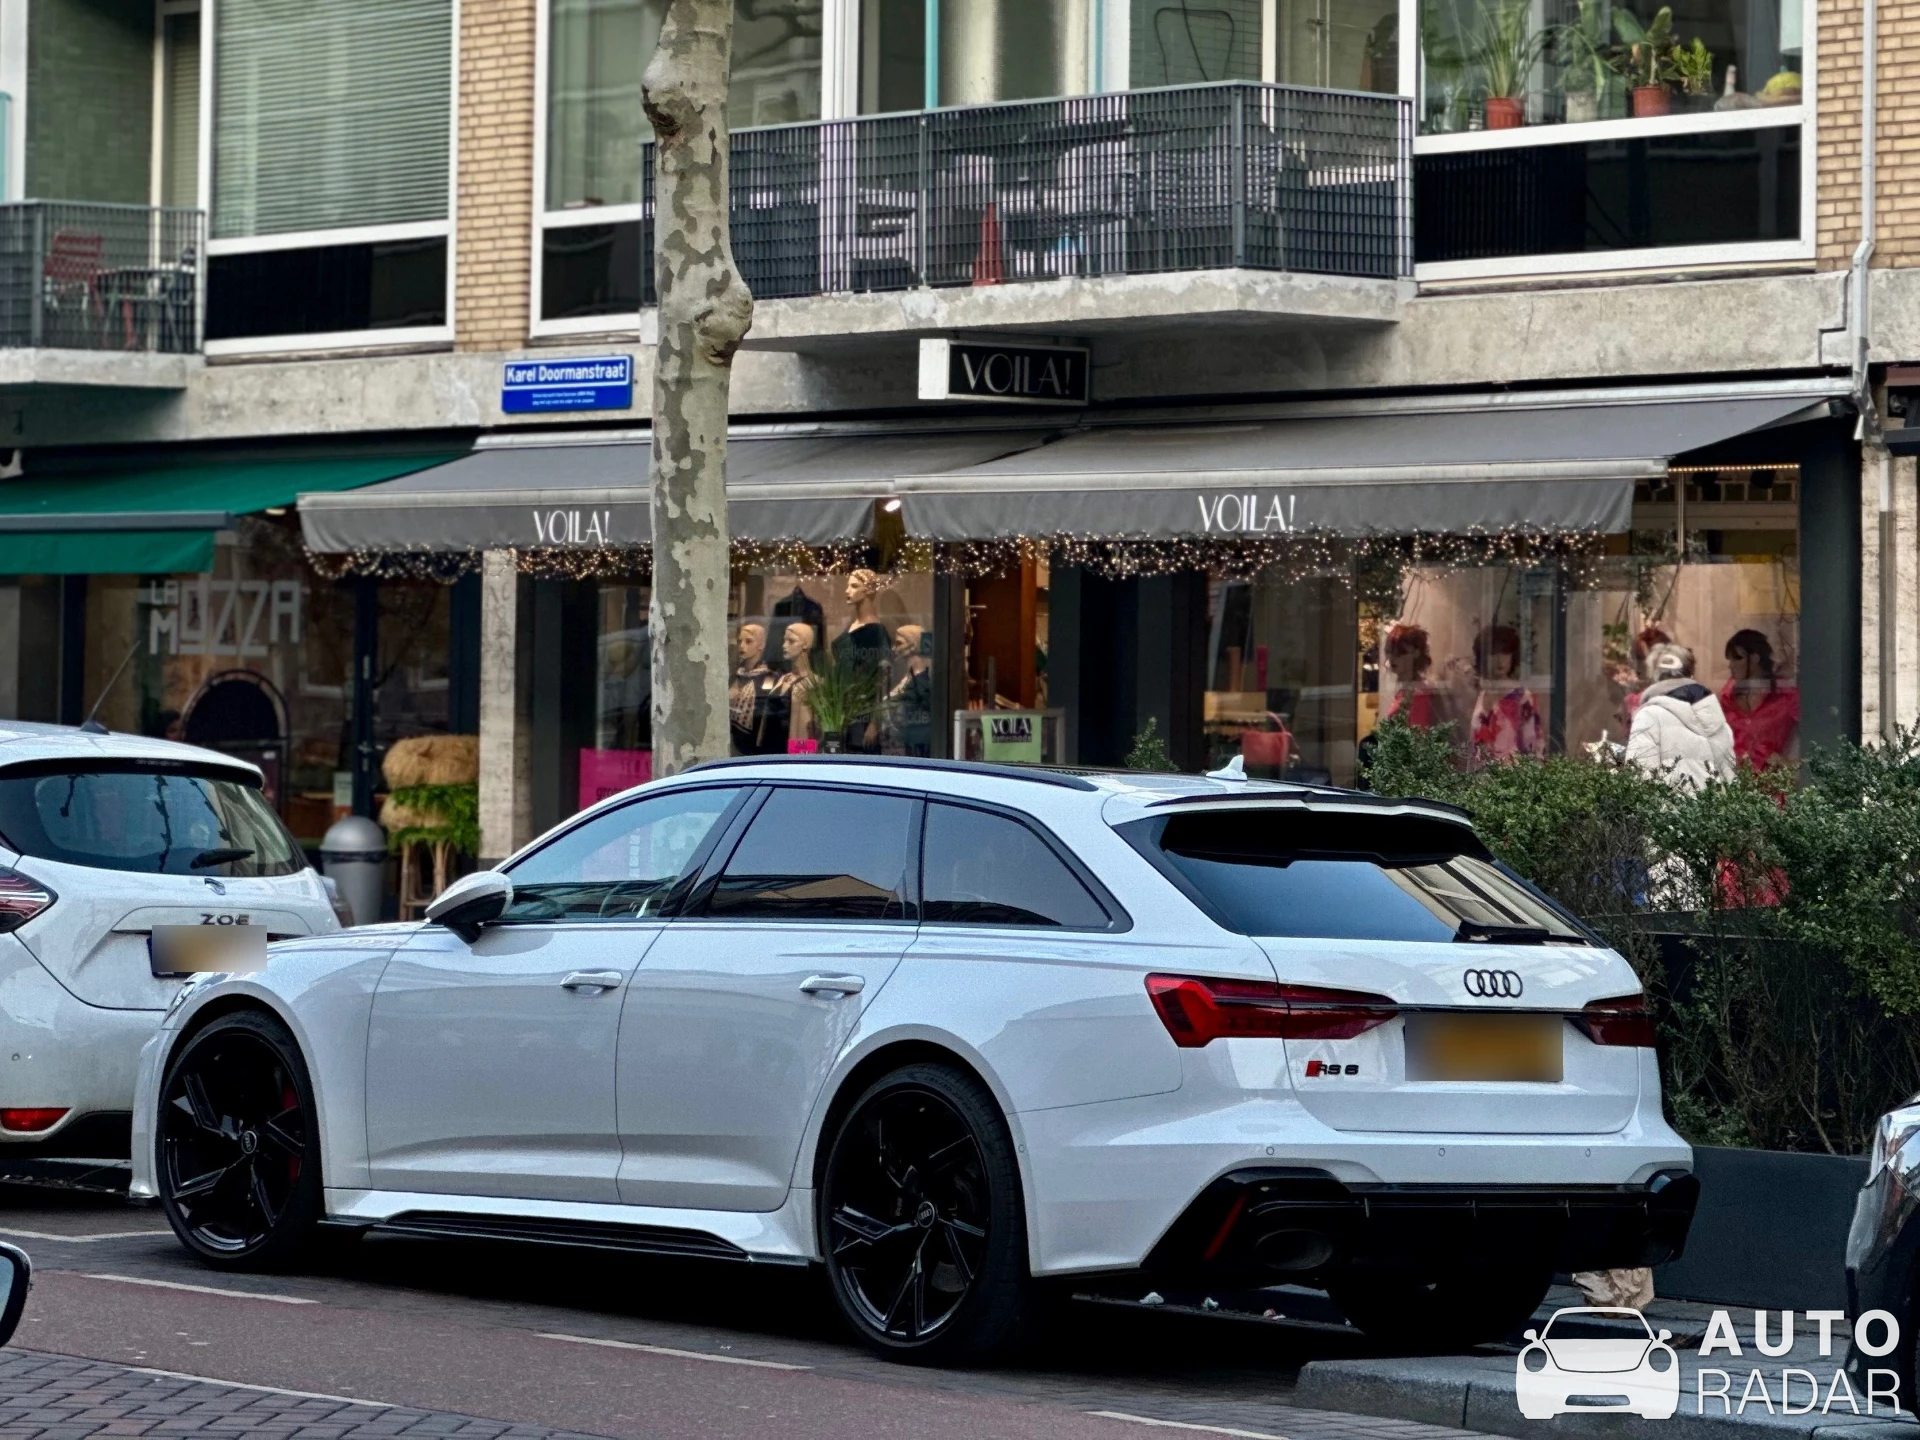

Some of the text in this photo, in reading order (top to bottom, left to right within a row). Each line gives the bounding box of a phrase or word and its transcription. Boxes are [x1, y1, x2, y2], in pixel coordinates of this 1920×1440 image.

[506, 363, 625, 383] Karel Doormanstraat
[962, 353, 1071, 395] VOILA!
[533, 510, 610, 544] VOILA!
[1198, 494, 1296, 532] VOILA!
[149, 580, 301, 656] MOZZA
[201, 913, 250, 926] ZOE
